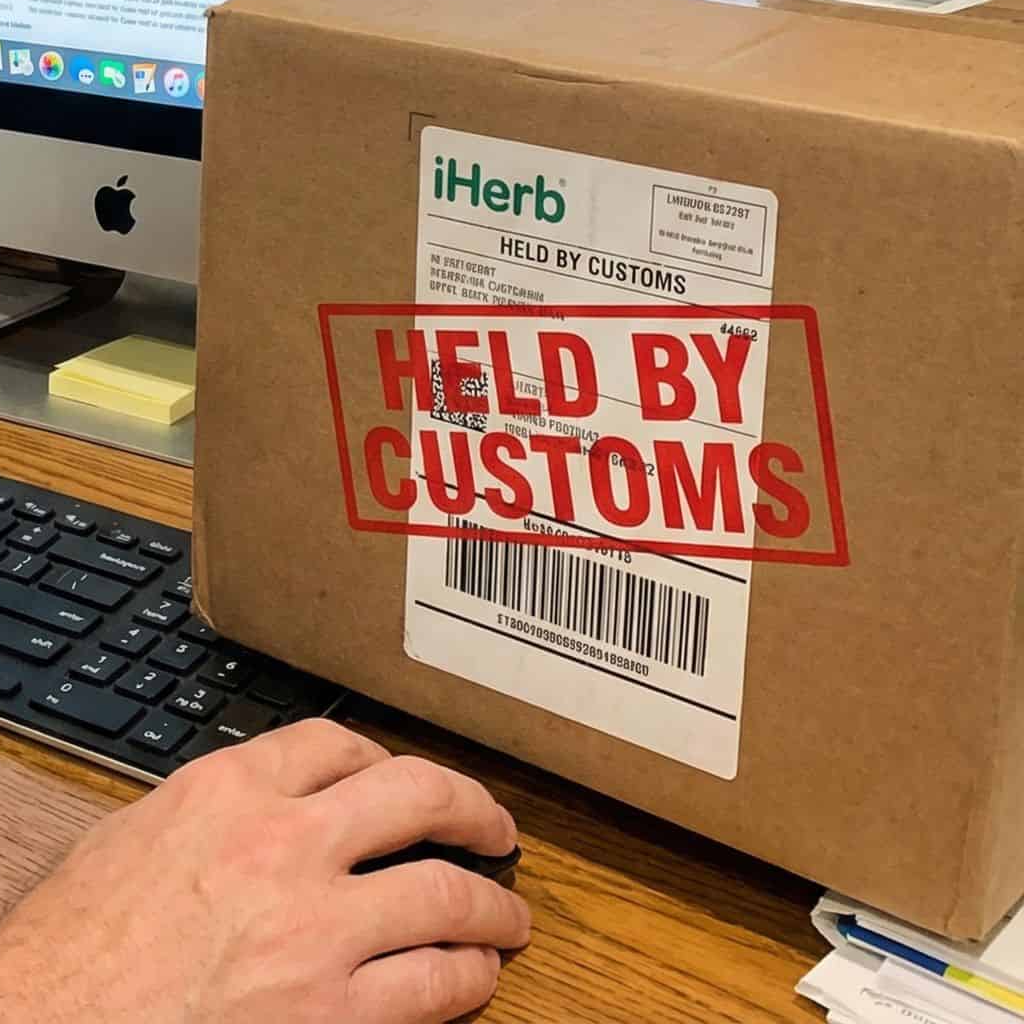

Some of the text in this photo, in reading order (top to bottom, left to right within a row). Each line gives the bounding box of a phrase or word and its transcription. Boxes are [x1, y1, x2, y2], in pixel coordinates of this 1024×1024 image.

[434, 155, 566, 224] iHerb
[500, 236, 687, 295] HELD BY CUSTOMS
[376, 330, 752, 424] HELD BY
[364, 426, 811, 538] CUSTOMS
